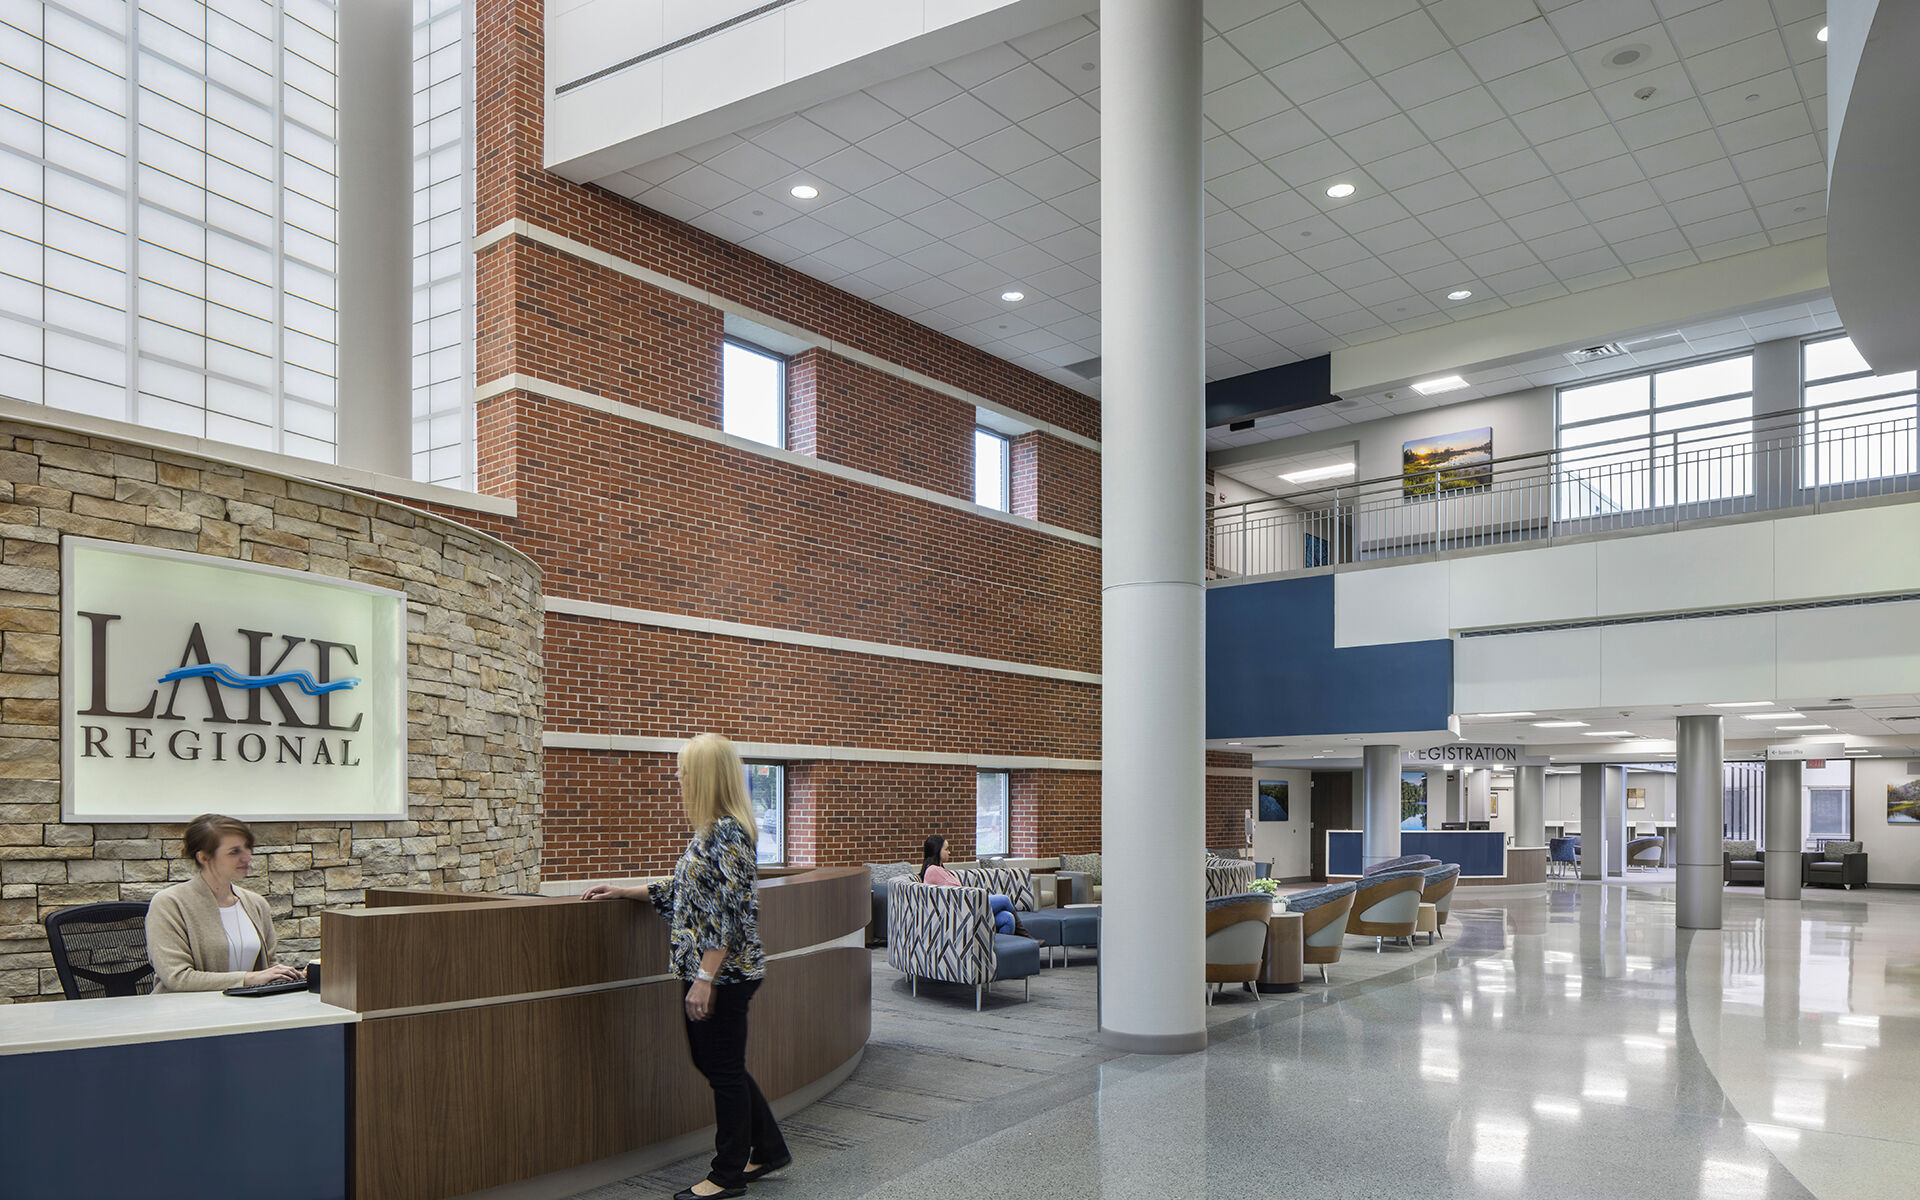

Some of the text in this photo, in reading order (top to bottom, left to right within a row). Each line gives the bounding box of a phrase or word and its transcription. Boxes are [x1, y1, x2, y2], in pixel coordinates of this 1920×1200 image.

[77, 611, 363, 732] LAKE
[80, 725, 360, 767] REGIONAL
[1408, 746, 1516, 760] REGISTRATION
